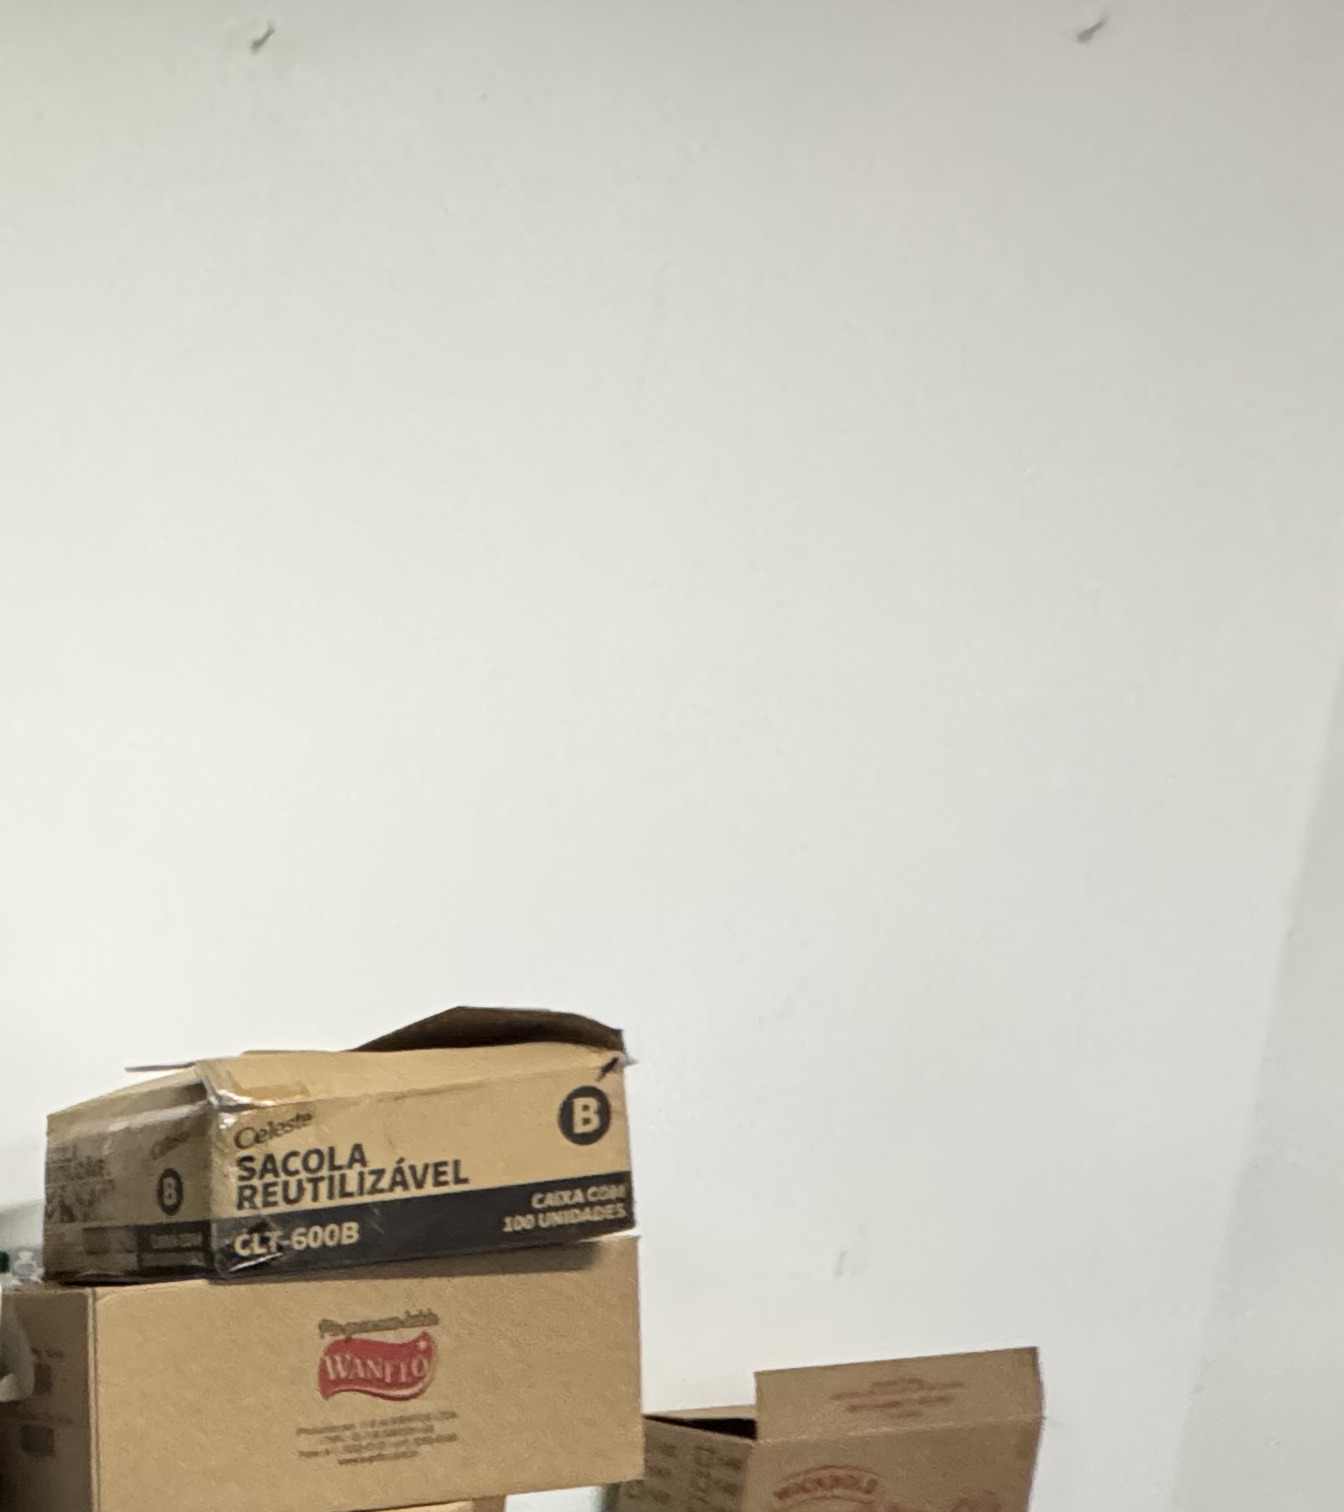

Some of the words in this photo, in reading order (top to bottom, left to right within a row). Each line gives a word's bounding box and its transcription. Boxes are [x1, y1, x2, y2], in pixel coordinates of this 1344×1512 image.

[233, 1111, 313, 1150] Celeste
[572, 1096, 602, 1135] B
[236, 1143, 368, 1182] SACOLA
[236, 1157, 470, 1211] REUTILIZÁVEL
[530, 1188, 586, 1209] CAIXA
[502, 1214, 535, 1232] 100
[537, 1203, 628, 1229] UNIDADES
[233, 1221, 360, 1257] CLT-600B
